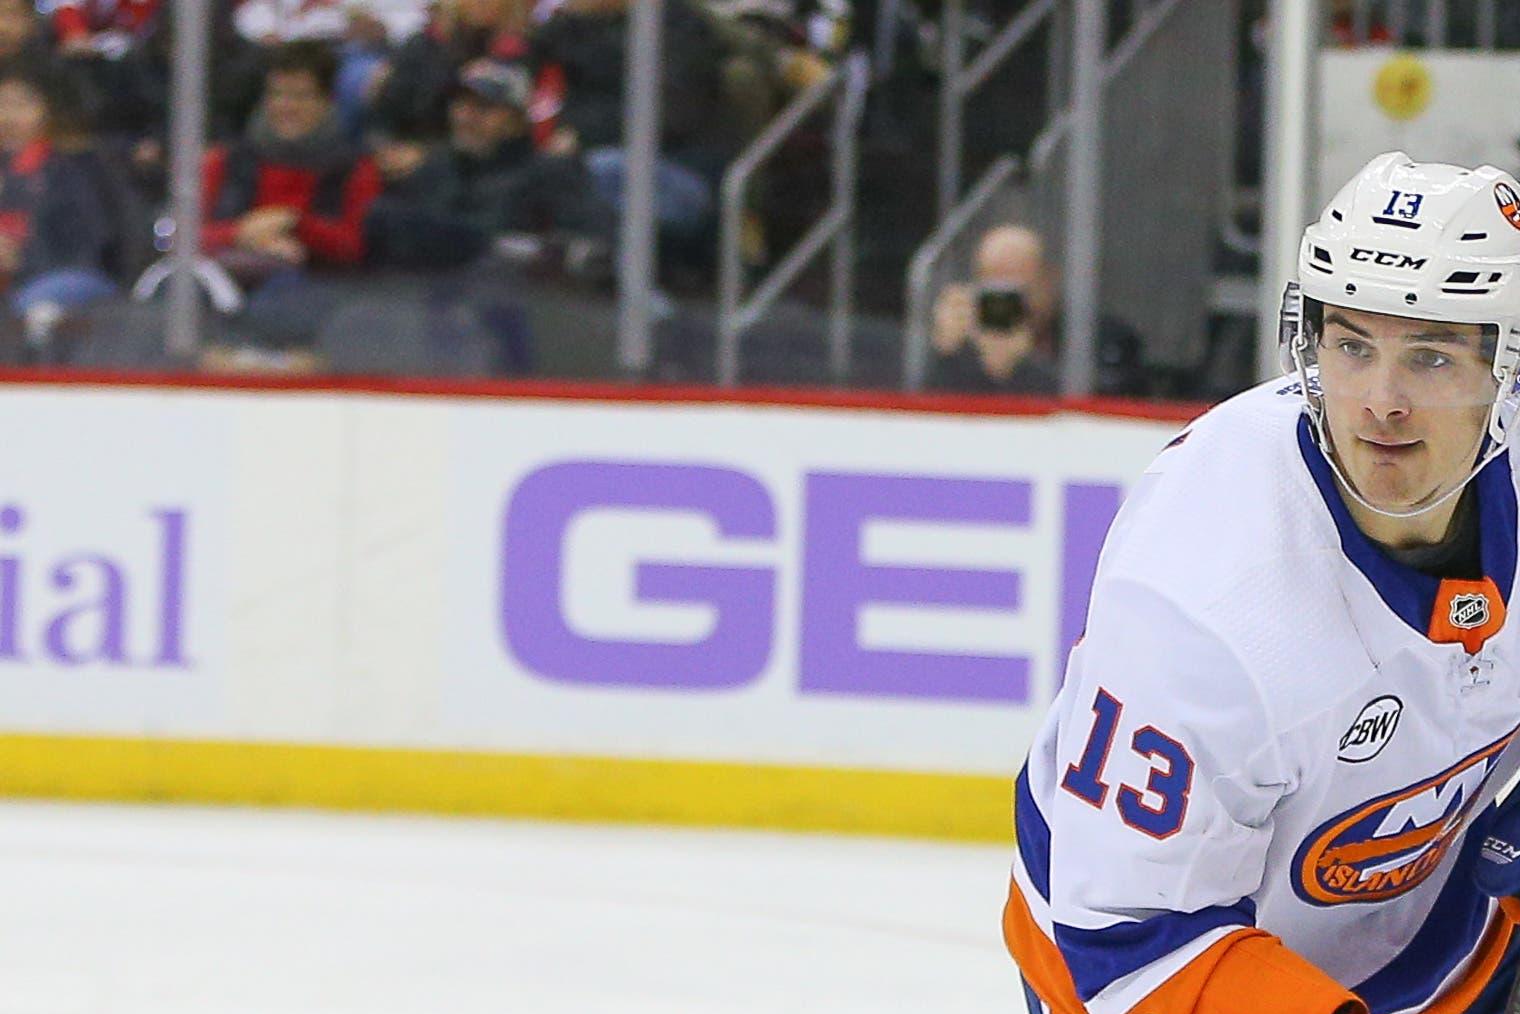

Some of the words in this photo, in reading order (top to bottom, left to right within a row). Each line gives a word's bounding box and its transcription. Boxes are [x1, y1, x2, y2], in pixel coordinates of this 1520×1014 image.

[1382, 189, 1424, 219] 13
[1350, 247, 1428, 271] CCM
[1456, 602, 1483, 623] NHL
[1338, 709, 1399, 752] CBW
[1062, 686, 1195, 842] 13
